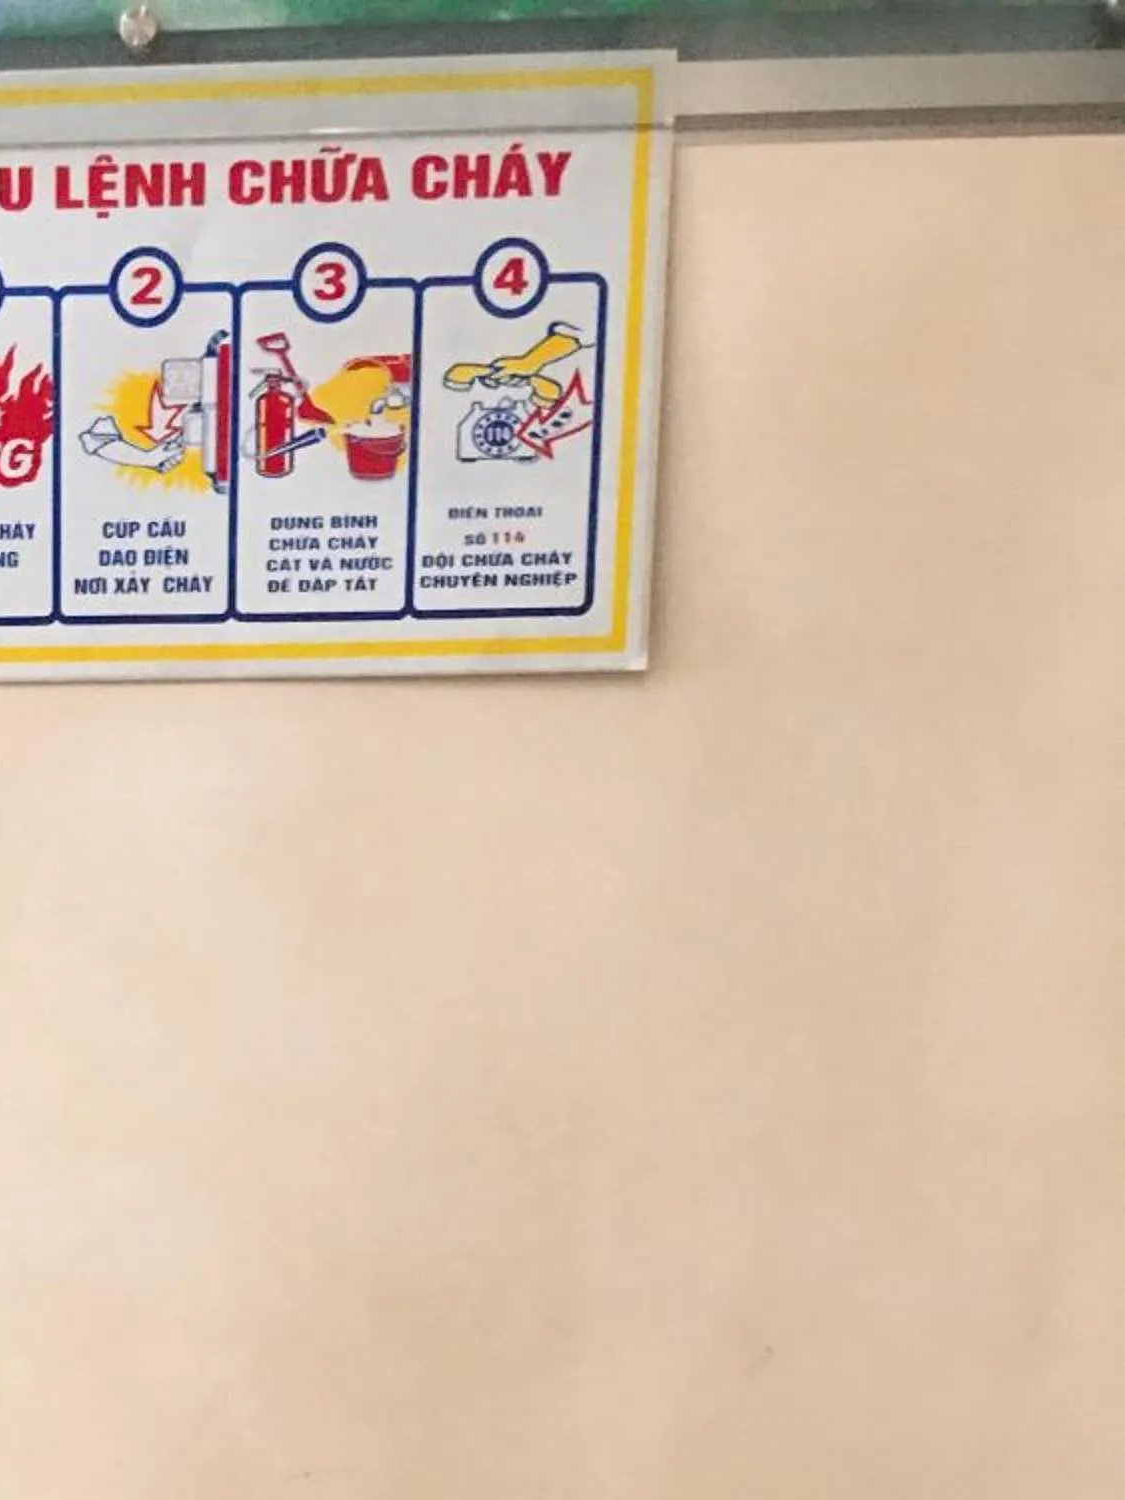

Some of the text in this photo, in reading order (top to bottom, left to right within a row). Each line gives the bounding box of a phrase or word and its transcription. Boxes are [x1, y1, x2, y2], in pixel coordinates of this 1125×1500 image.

[55, 154, 206, 219] LỆNH
[228, 146, 389, 206] CHỮA
[412, 143, 572, 200] CHÁY
[130, 267, 163, 305] 2
[313, 262, 347, 301] 3
[492, 257, 529, 295] 4
[99, 549, 138, 568] DAO
[74, 577, 107, 595] NƠI
[114, 570, 150, 594] XẢY
[419, 572, 498, 590] CHUYÊN
